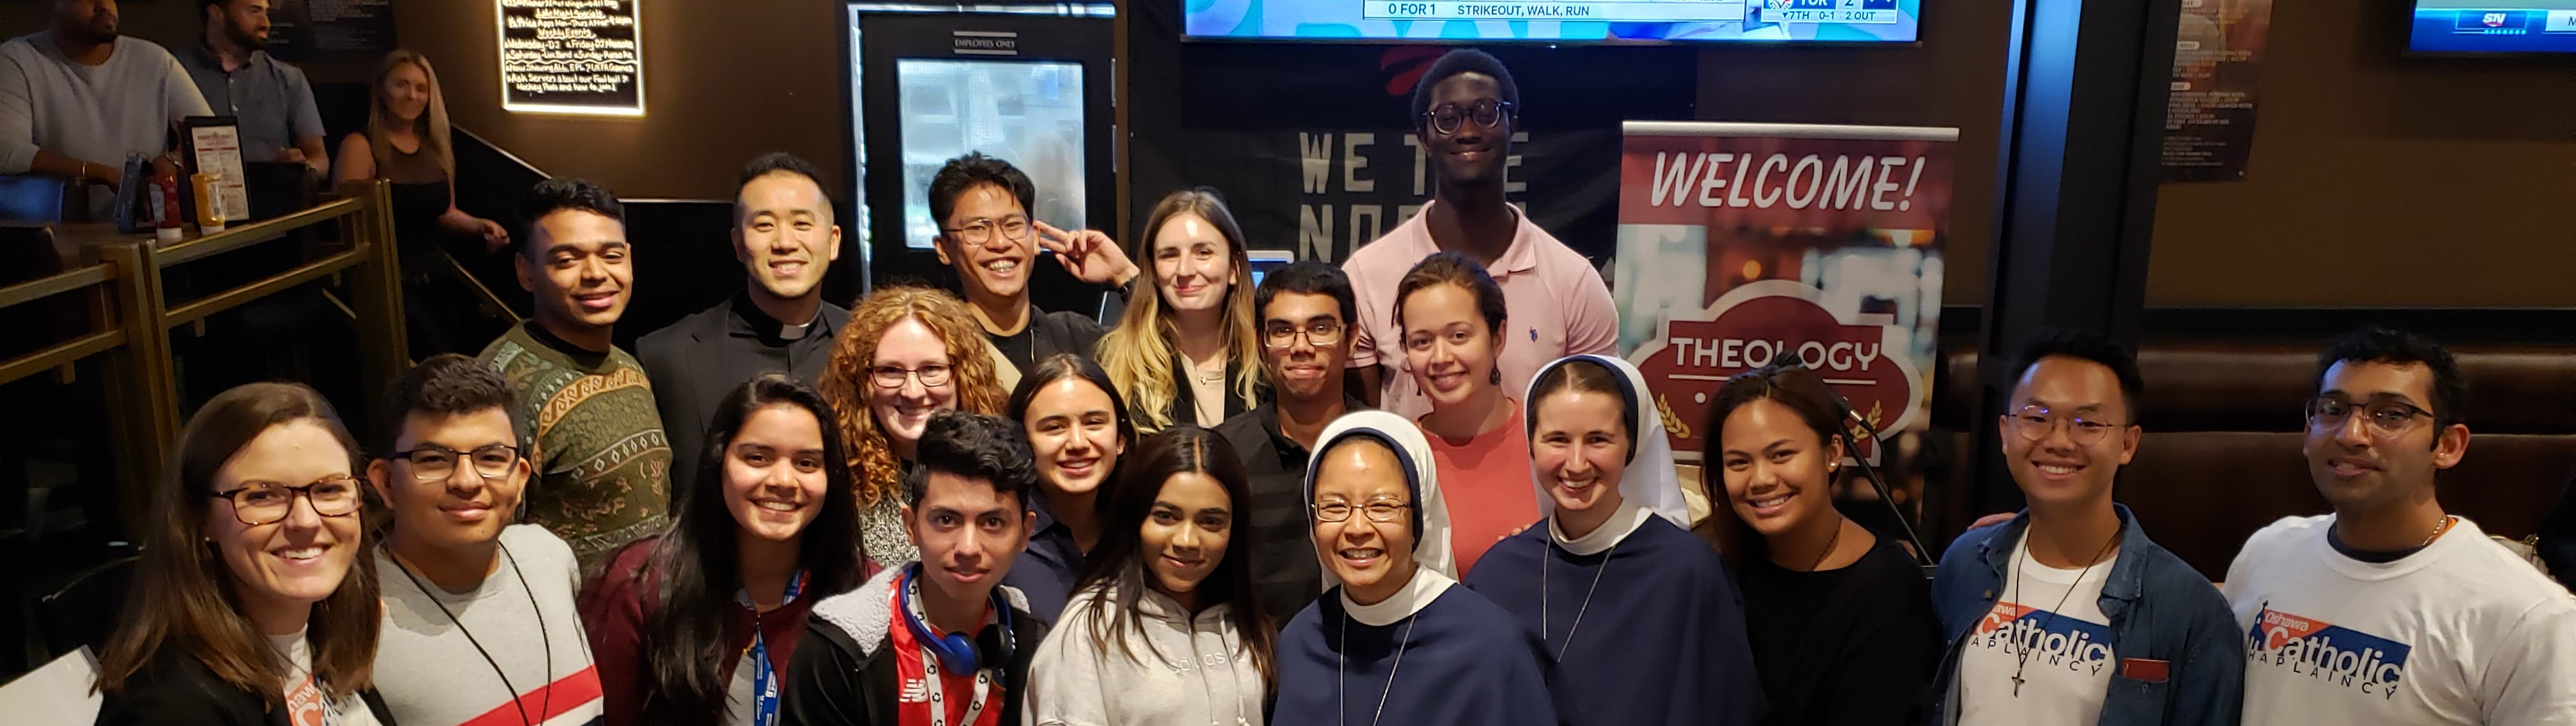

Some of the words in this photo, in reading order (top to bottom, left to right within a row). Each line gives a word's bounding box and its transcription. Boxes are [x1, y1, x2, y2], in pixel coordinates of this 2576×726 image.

[1388, 4, 1397, 15] 0
[1400, 4, 1426, 15] FOR
[1430, 4, 1436, 15] 1
[1457, 5, 1524, 17] STRIKEOUT,
[1527, 6, 1563, 17] WALK,
[1565, 6, 1590, 16] RUN
[1790, 11, 1810, 20] 7TH
[1819, 11, 1835, 20] 0-1
[1845, 12, 1851, 20] 2
[1854, 12, 1876, 20] OUT
[995, 40, 1015, 48] ONLY
[1300, 132, 1375, 194] WE
[1404, 132, 1529, 196] TE
[1650, 151, 1926, 212] WELCOME!
[1977, 612, 2108, 663] Catholic
[2265, 611, 2309, 631] Oshawa
[1971, 636, 2102, 677] APLAINCY
[2248, 649, 2396, 700] HAPLAINCY
[2264, 626, 2400, 685] Catholic
